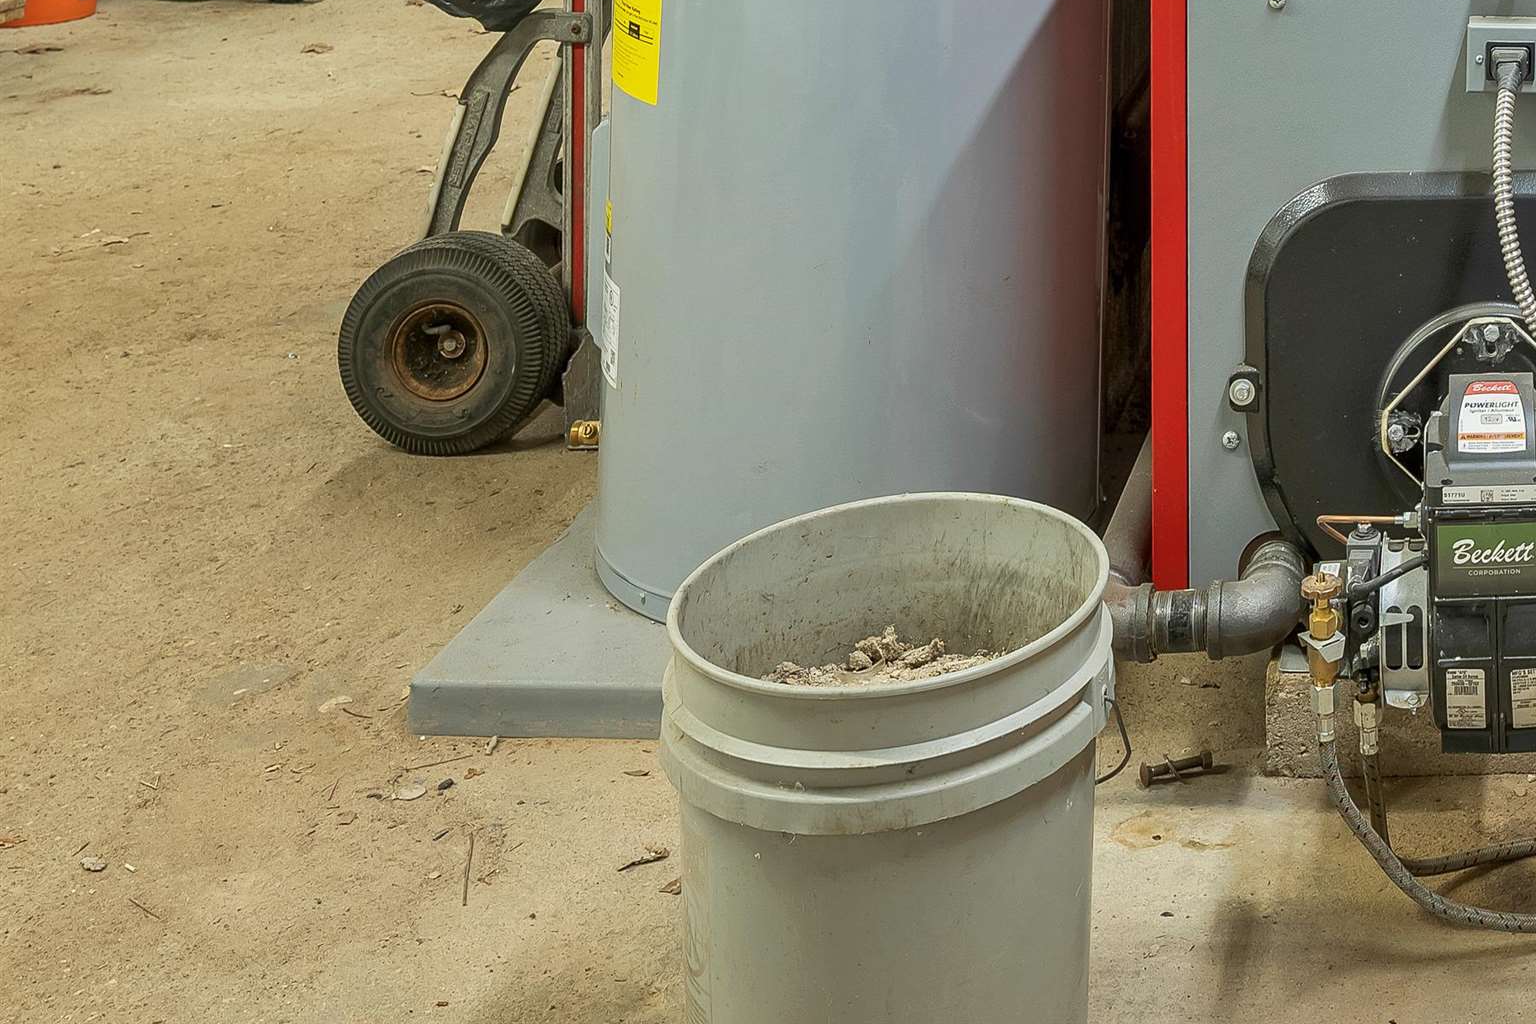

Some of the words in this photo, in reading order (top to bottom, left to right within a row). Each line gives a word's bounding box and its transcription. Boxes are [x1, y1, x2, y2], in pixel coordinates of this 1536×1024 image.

[1471, 384, 1512, 392] Beckett
[1452, 538, 1535, 565] Beckett
[1468, 568, 1521, 576] CORPORATION
